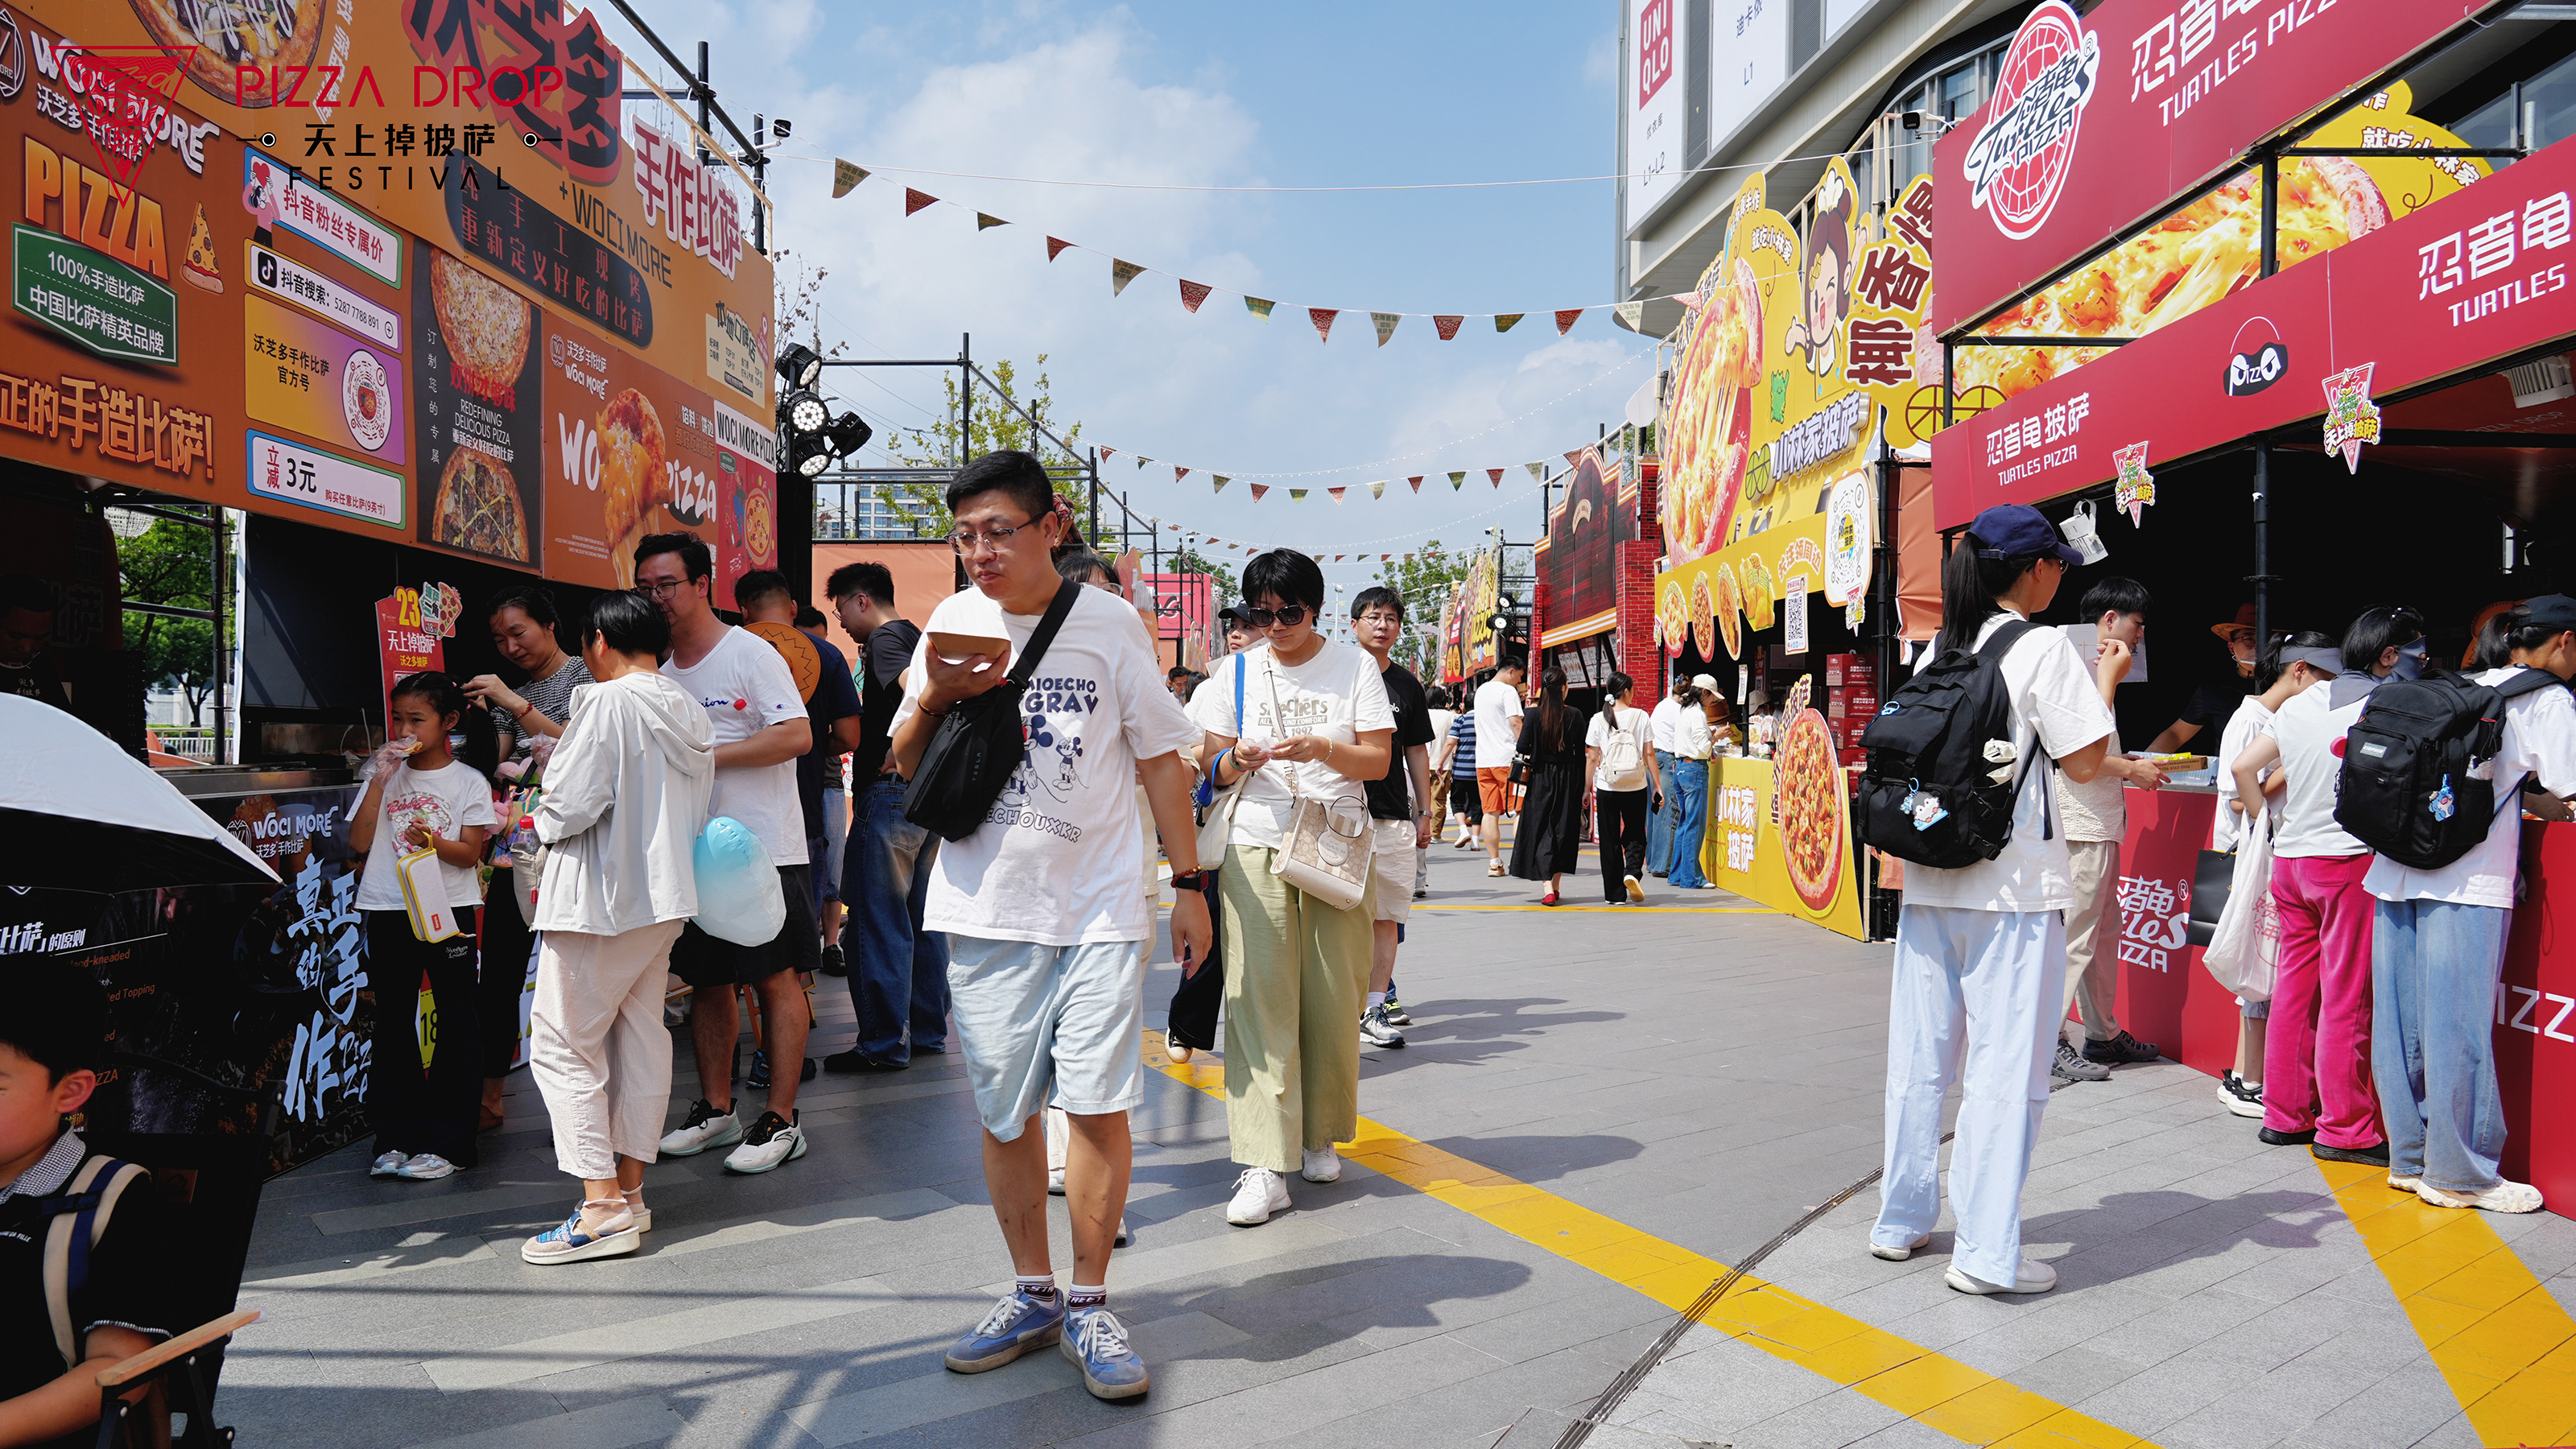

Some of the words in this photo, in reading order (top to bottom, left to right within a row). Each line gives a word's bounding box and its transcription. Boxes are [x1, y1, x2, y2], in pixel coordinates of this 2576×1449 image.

[1643, 0, 1667, 52] UNI
[1642, 36, 1669, 95] QLO
[1744, 60, 1753, 86] L1
[2158, 27, 2258, 126] TURTLES
[1646, 113, 1664, 141] 优衣库
[2016, 109, 2073, 166] PIZZA
[1643, 151, 1666, 187] L1-L2
[25, 134, 170, 281] PIZZA
[634, 122, 741, 279] 手作比萨
[283, 184, 385, 265] 抖音粉丝专属价
[460, 159, 641, 304] 纯手工现烤
[2418, 191, 2571, 301] 忍者龟
[47, 251, 146, 306] 100%手造比萨
[460, 204, 644, 339] 重新定义好吃的比萨
[2448, 262, 2566, 327] TURTLES
[30, 284, 165, 356] 中国比萨精英品牌
[253, 332, 330, 377] 沃芝多手作比萨
[277, 365, 311, 393] 官方号
[450, 362, 517, 414] 双拼才够味
[565, 363, 584, 386] WOCI
[586, 375, 609, 401] MORE
[454, 412, 491, 440] DELICIOUS
[492, 427, 511, 447] PIZZA
[460, 398, 502, 427] REDEFINING
[1986, 391, 2090, 468] 忍者龟披萨
[452, 428, 514, 464] 重新定义好吃的比萨
[716, 410, 738, 445] WOCI
[739, 426, 759, 456] MORE
[759, 433, 776, 468] PIZZA
[1773, 390, 1860, 482] 小林家披萨
[2326, 418, 2378, 452] 天上掉披萨
[266, 446, 280, 490] 立减
[287, 456, 317, 494] 3元
[1998, 457, 2041, 486] TURTLES
[2043, 444, 2078, 470] PIZZA
[324, 489, 386, 516] 购买任意比萨(9英寸)
[2117, 484, 2153, 509] 天上掉披萨
[396, 588, 421, 628] 23
[387, 630, 436, 654] 天上掉披萨
[1290, 726, 1313, 737] 1992
[1298, 716, 1326, 724] COMFORT
[253, 814, 291, 840] WOCI
[296, 805, 339, 838] MORE
[1715, 782, 1755, 830] 小林家
[255, 838, 304, 859] 沃芝多手作比萨
[1727, 828, 1755, 875] 披萨
[123, 984, 155, 1000] Topping
[420, 1009, 438, 1046] 18
